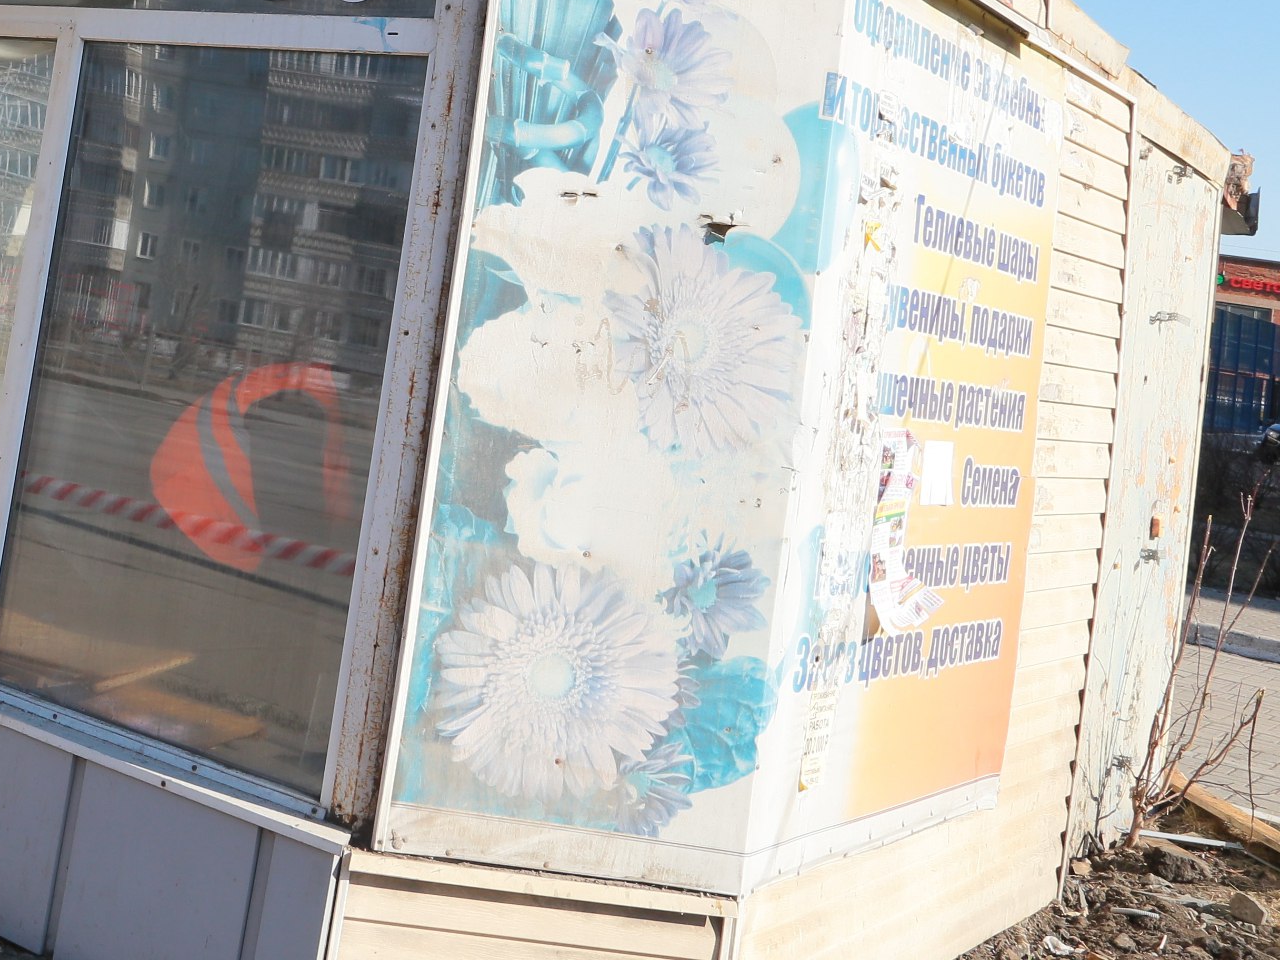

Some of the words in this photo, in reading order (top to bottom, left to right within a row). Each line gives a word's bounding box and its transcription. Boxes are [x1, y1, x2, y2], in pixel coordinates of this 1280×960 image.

[974, 58, 1048, 134] свадебны
[992, 143, 1046, 208] букетов
[914, 194, 996, 268] Гелиевые
[997, 233, 1039, 282] шары
[970, 306, 1033, 356] подарки
[955, 384, 1026, 430] растения
[961, 457, 1021, 506] Семена
[960, 545, 1011, 590] цветы
[858, 631, 924, 688] цветов,
[926, 620, 1002, 675] доставка
